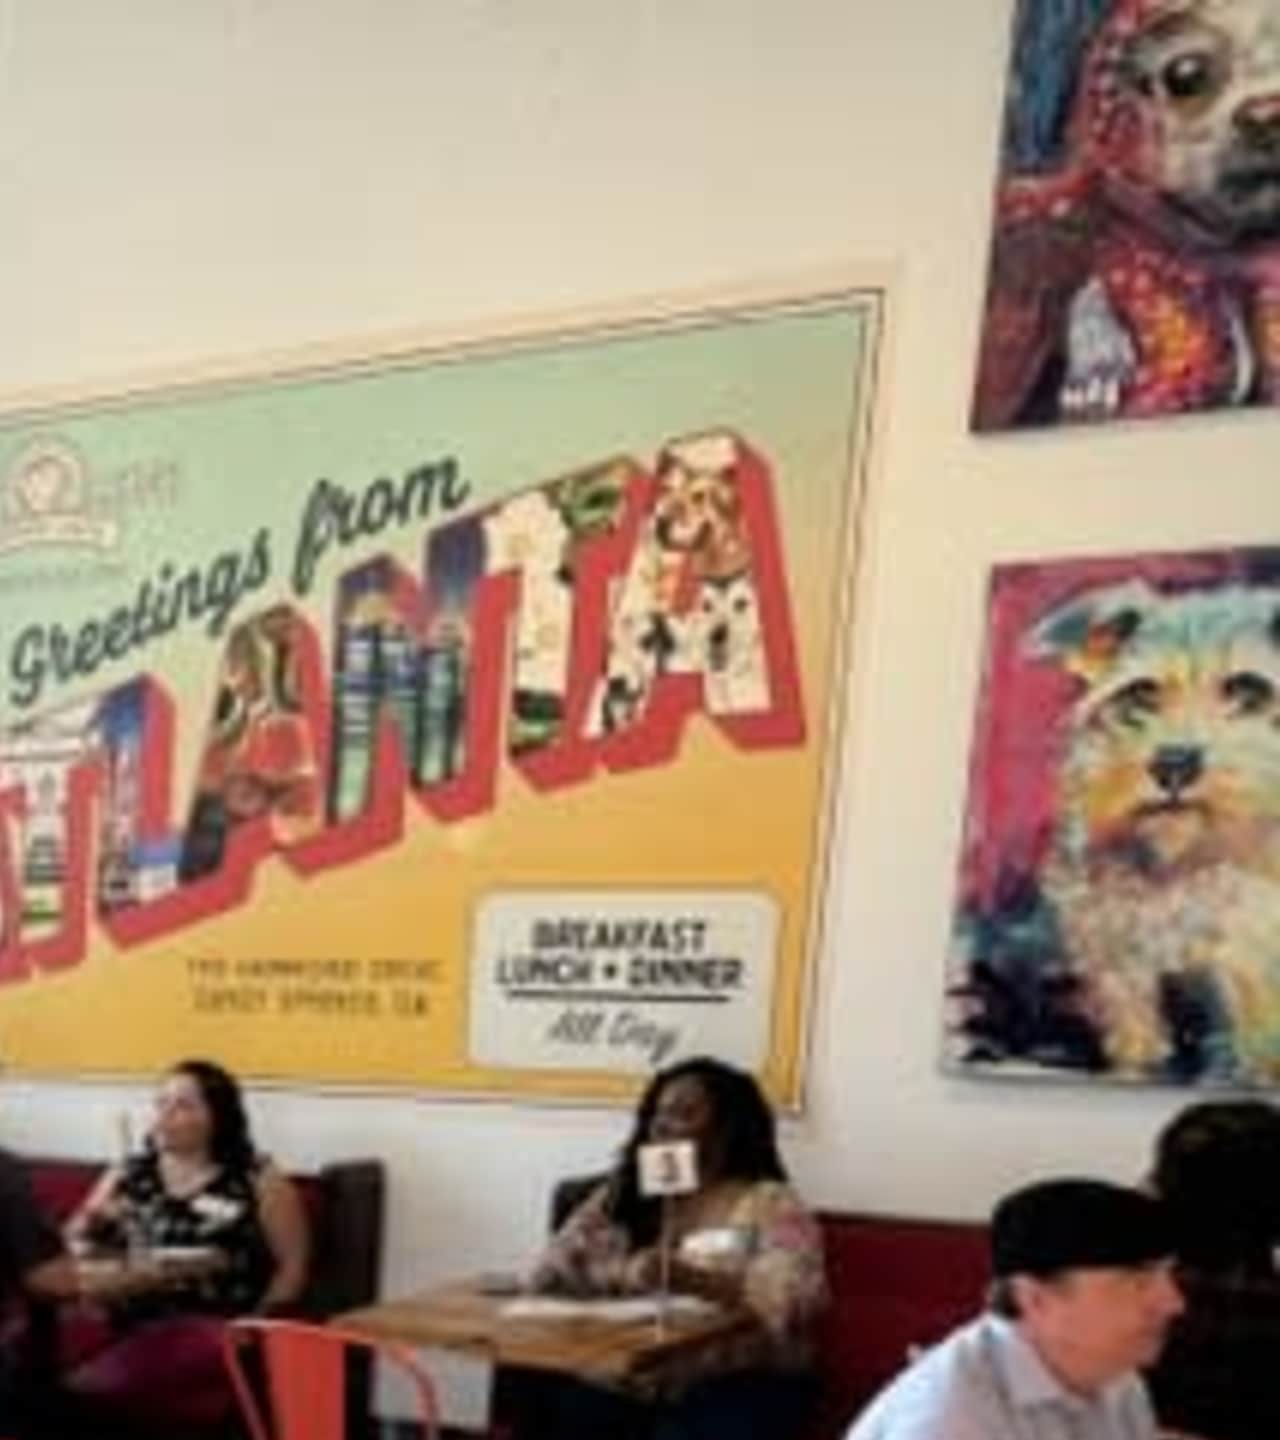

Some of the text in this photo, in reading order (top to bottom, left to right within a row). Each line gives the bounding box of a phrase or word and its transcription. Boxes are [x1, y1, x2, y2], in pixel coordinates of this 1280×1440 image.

[10, 456, 471, 706] Greetings from
[533, 918, 706, 952] BREAKFAST
[495, 955, 744, 990] LUNCH DINNER
[548, 1008, 680, 1065] All Day
